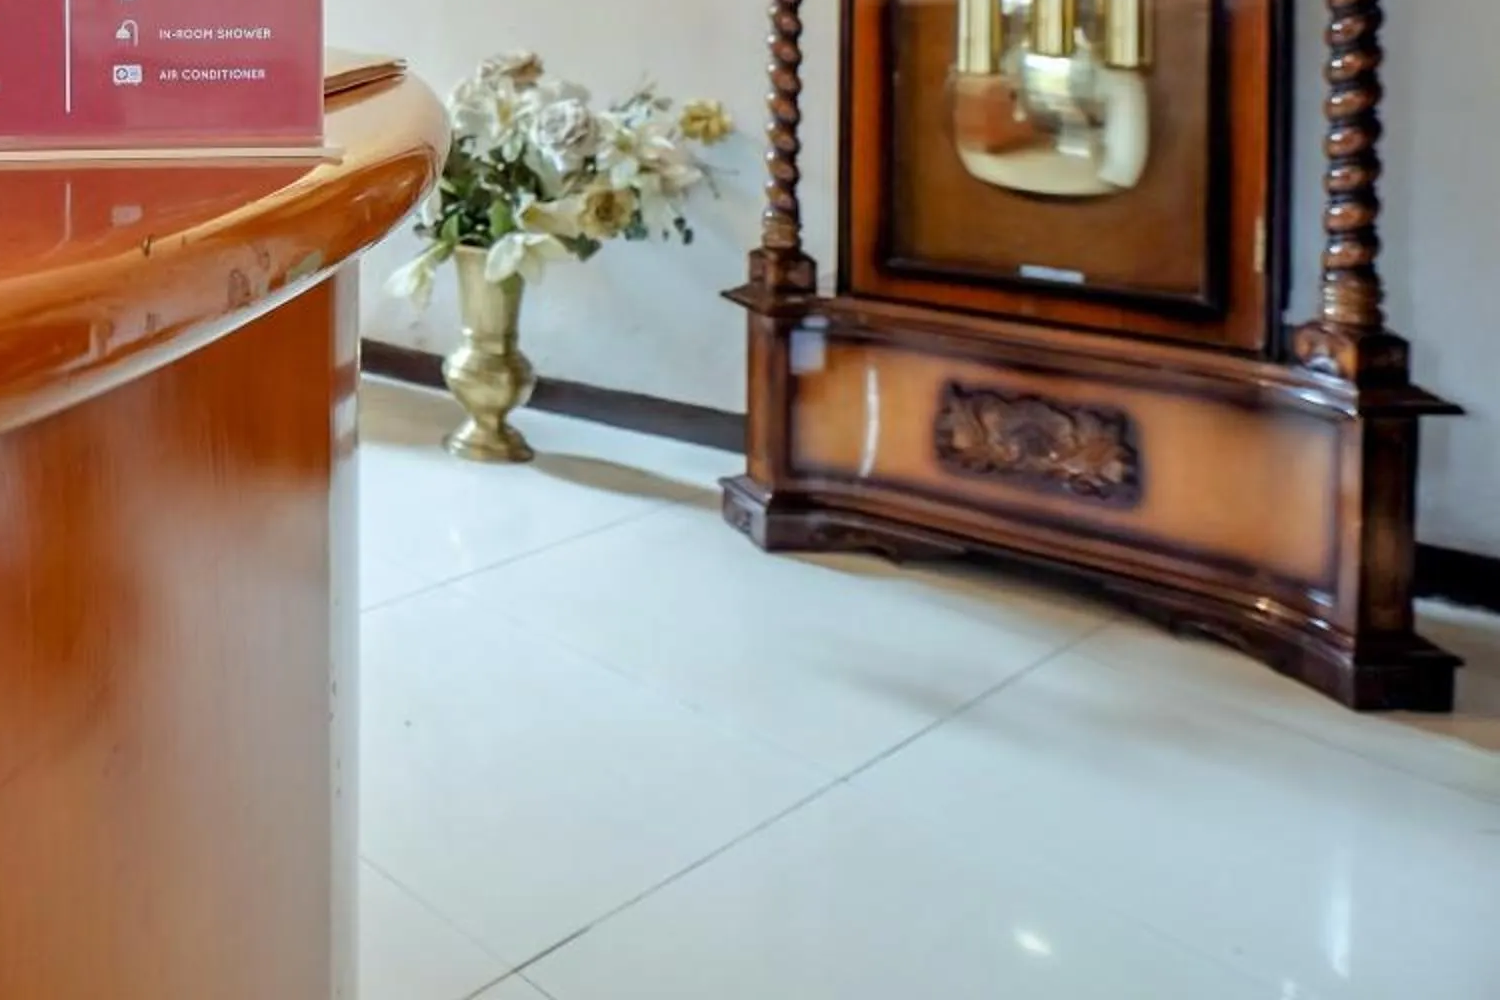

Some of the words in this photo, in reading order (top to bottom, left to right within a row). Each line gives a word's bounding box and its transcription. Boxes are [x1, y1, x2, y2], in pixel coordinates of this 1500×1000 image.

[158, 28, 214, 40] IN-ROOM
[217, 28, 272, 40] SHOWER
[159, 69, 178, 82] AIR
[181, 68, 266, 81] CONDITIONER
